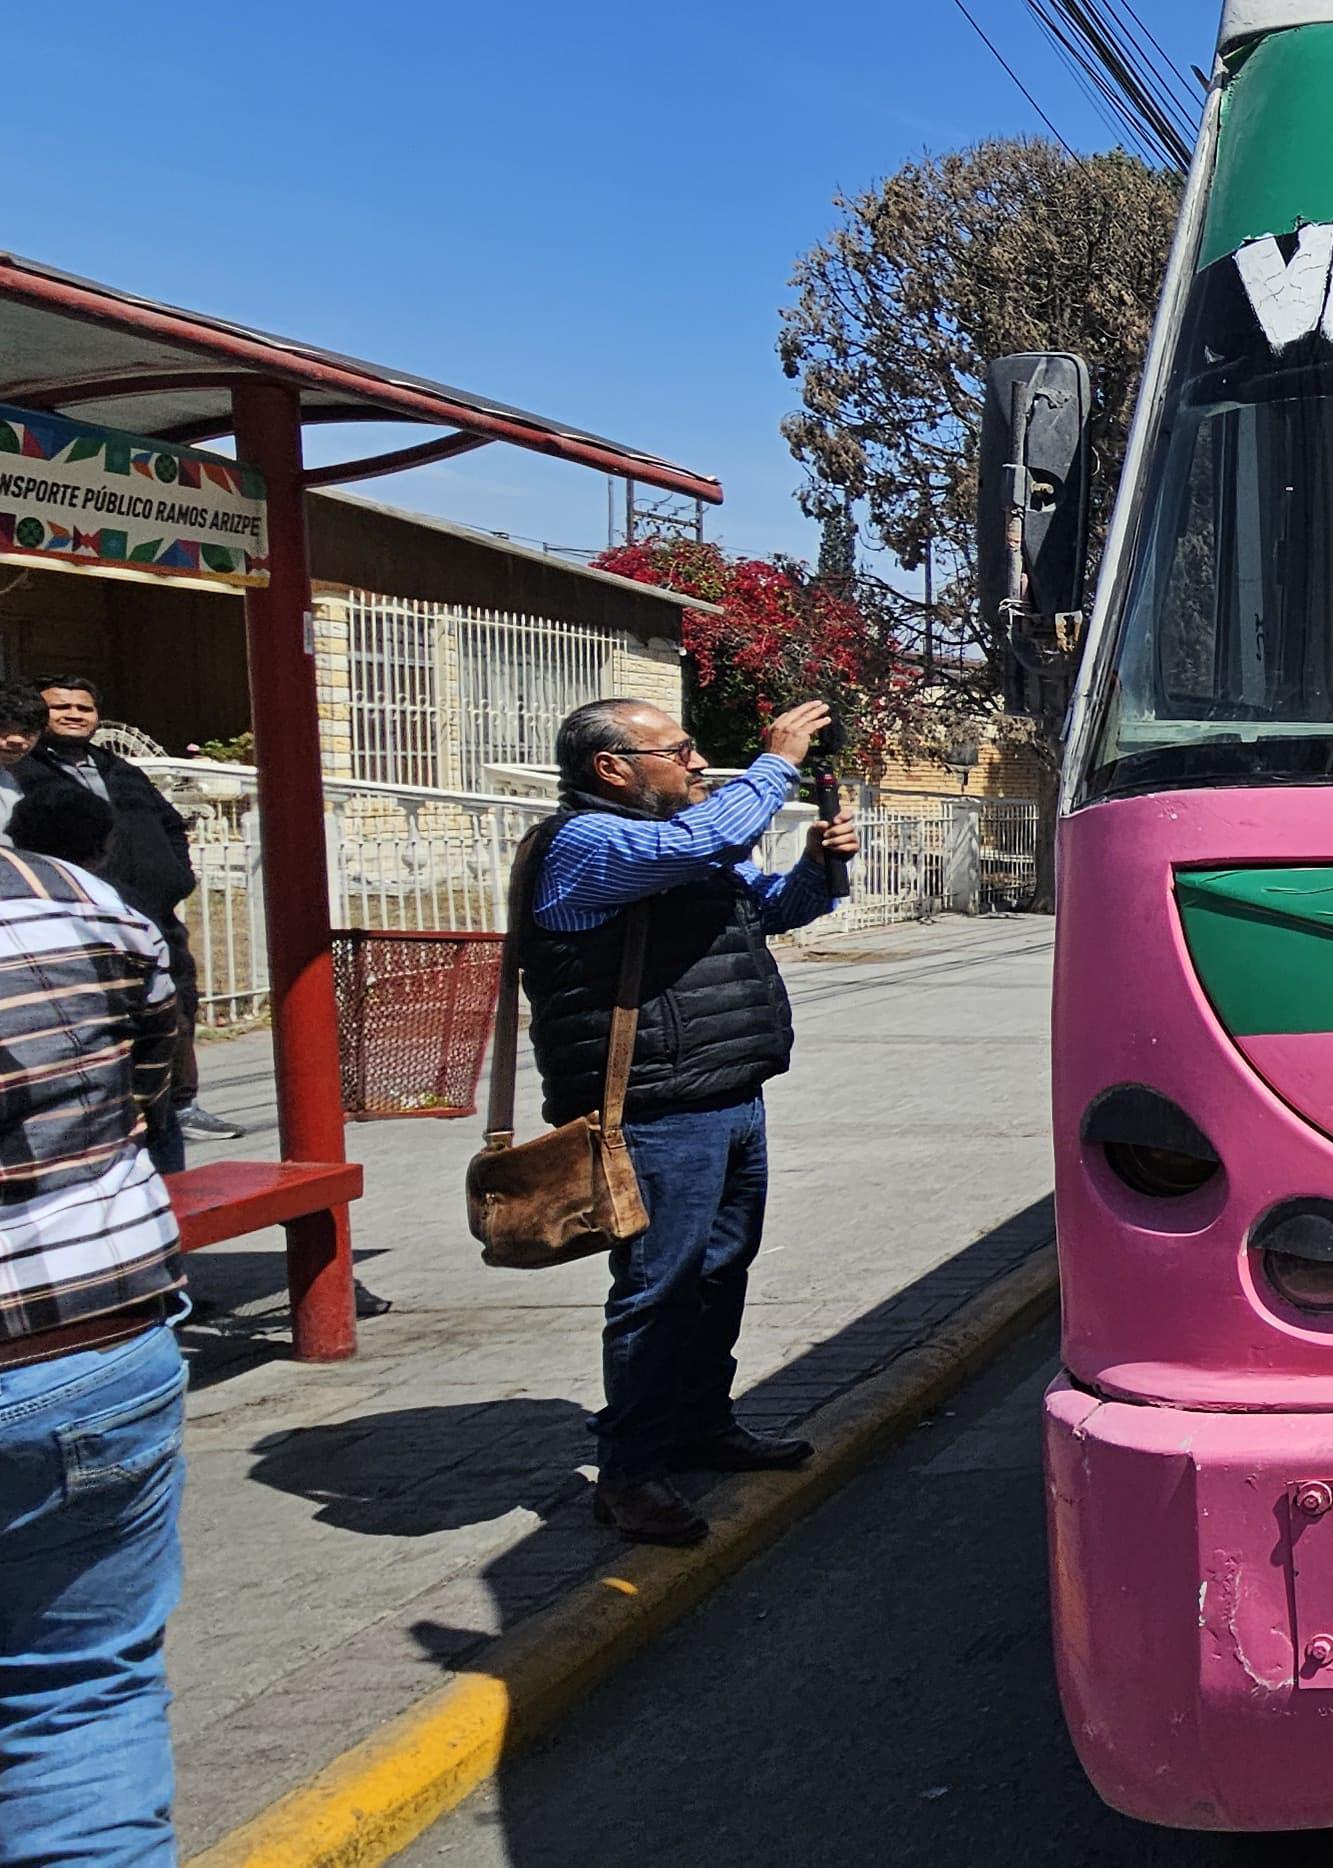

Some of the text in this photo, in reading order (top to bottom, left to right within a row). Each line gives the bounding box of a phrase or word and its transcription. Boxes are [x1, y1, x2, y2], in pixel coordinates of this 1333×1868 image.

[81, 484, 152, 520] PÚBLICO
[155, 501, 207, 529] RAMOS
[209, 510, 262, 537] ARIZPE
